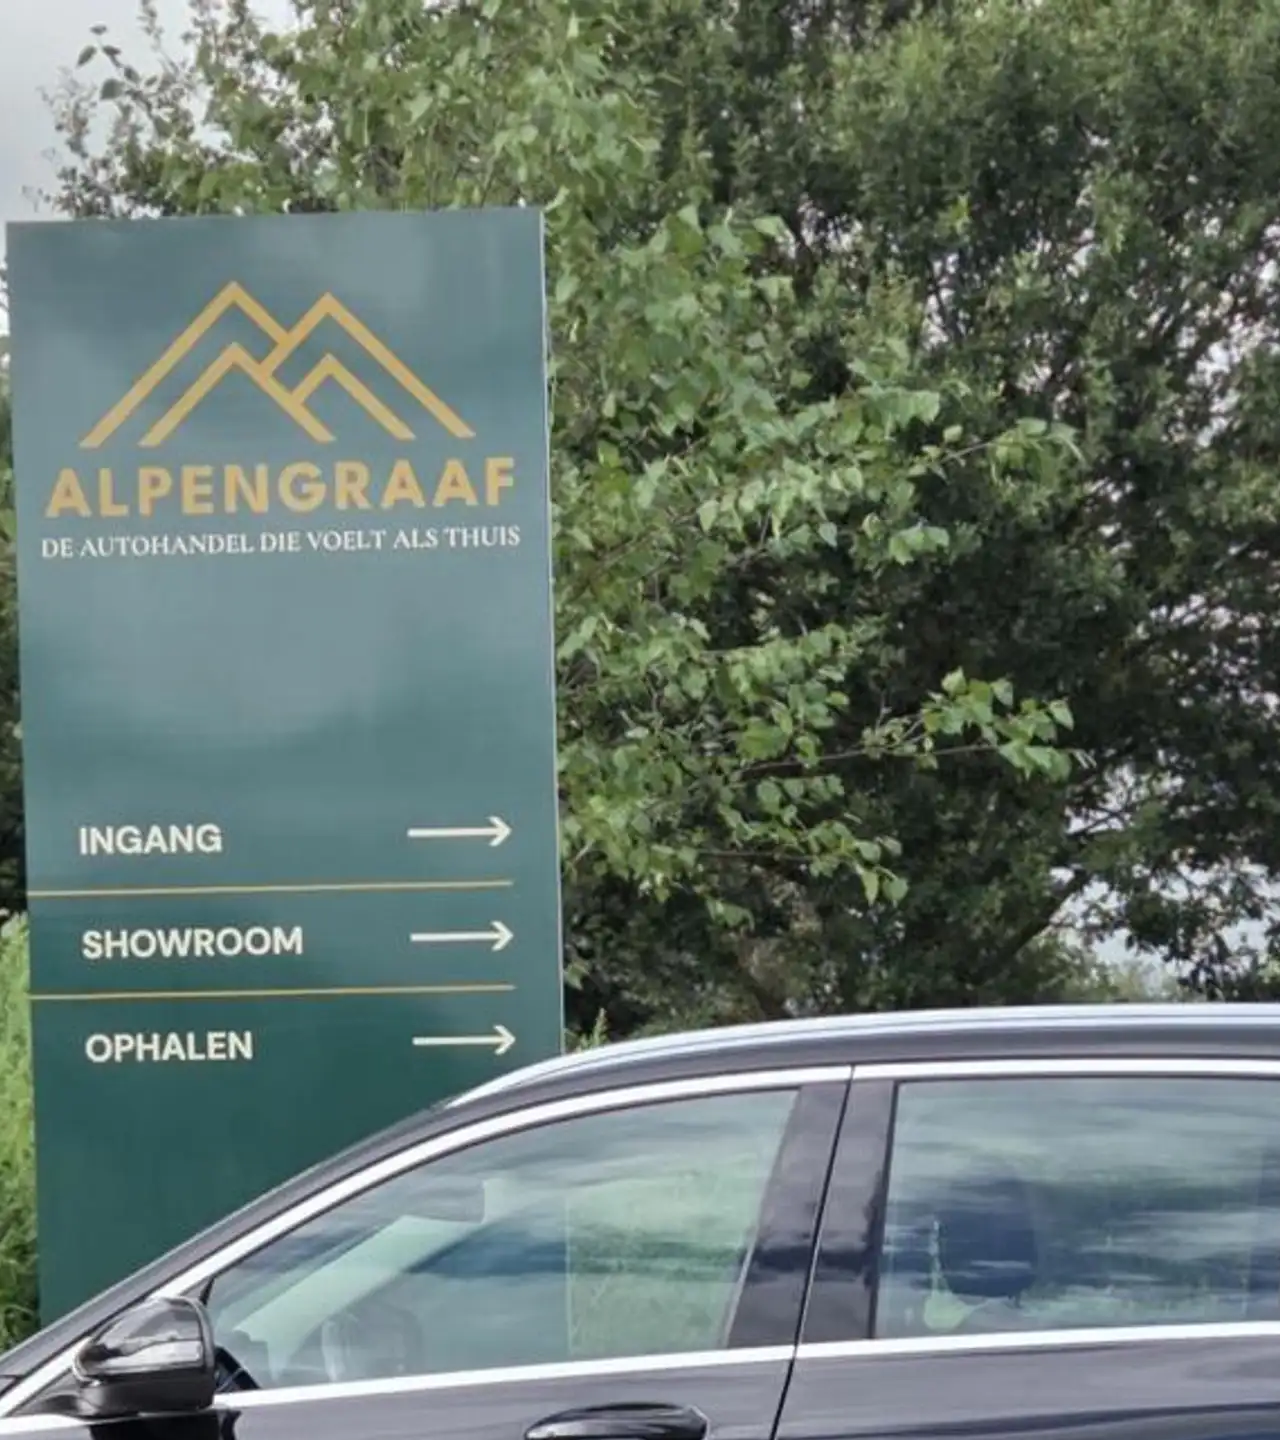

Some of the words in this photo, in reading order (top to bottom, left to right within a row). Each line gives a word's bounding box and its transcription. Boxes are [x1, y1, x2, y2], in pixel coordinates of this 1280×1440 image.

[43, 456, 516, 519] ALPENGRAAF
[41, 537, 74, 559] DE
[80, 533, 255, 557] AUTOHANDEL
[260, 531, 302, 553] DIE
[307, 529, 387, 552] VOELT
[393, 526, 440, 549] ALS
[442, 524, 521, 548] THUIS
[79, 822, 223, 856] INGANG
[81, 925, 304, 960] SHOWROOM
[84, 1030, 254, 1064] OPHALEN
